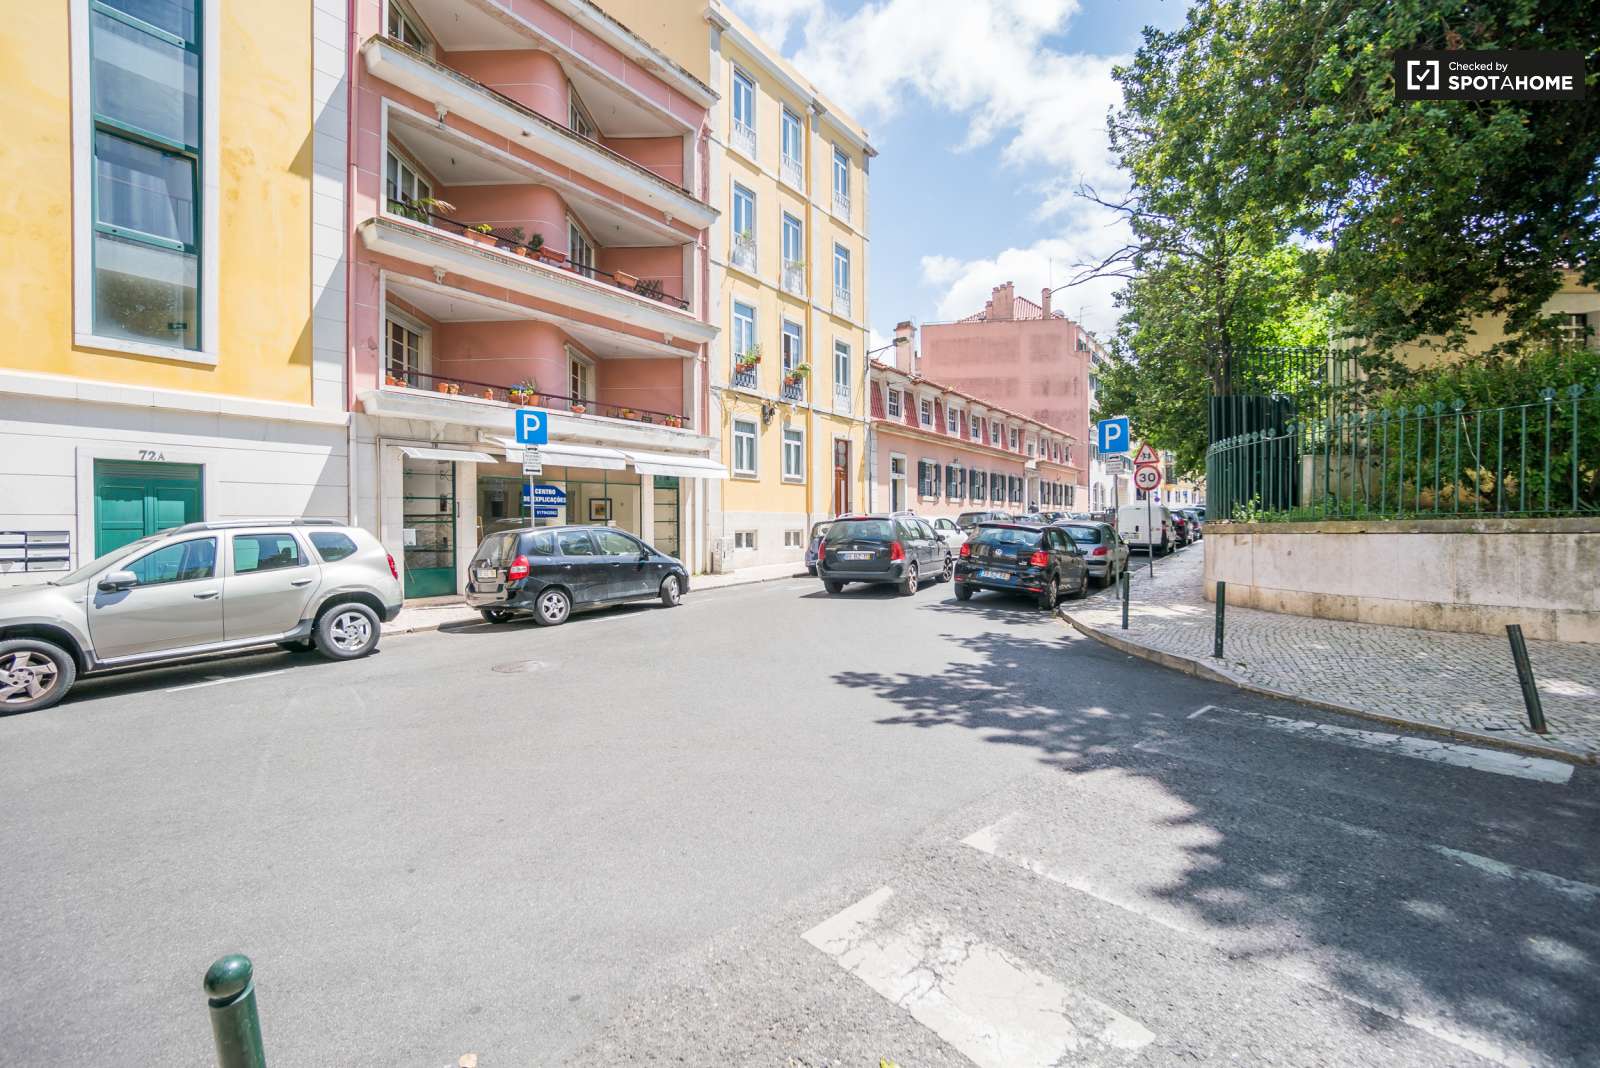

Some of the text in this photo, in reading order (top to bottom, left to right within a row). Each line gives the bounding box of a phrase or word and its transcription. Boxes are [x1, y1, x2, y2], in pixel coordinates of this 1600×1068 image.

[523, 413, 541, 440] P
[1105, 423, 1122, 449] P
[138, 449, 166, 461] 72A
[1138, 472, 1157, 483] 30
